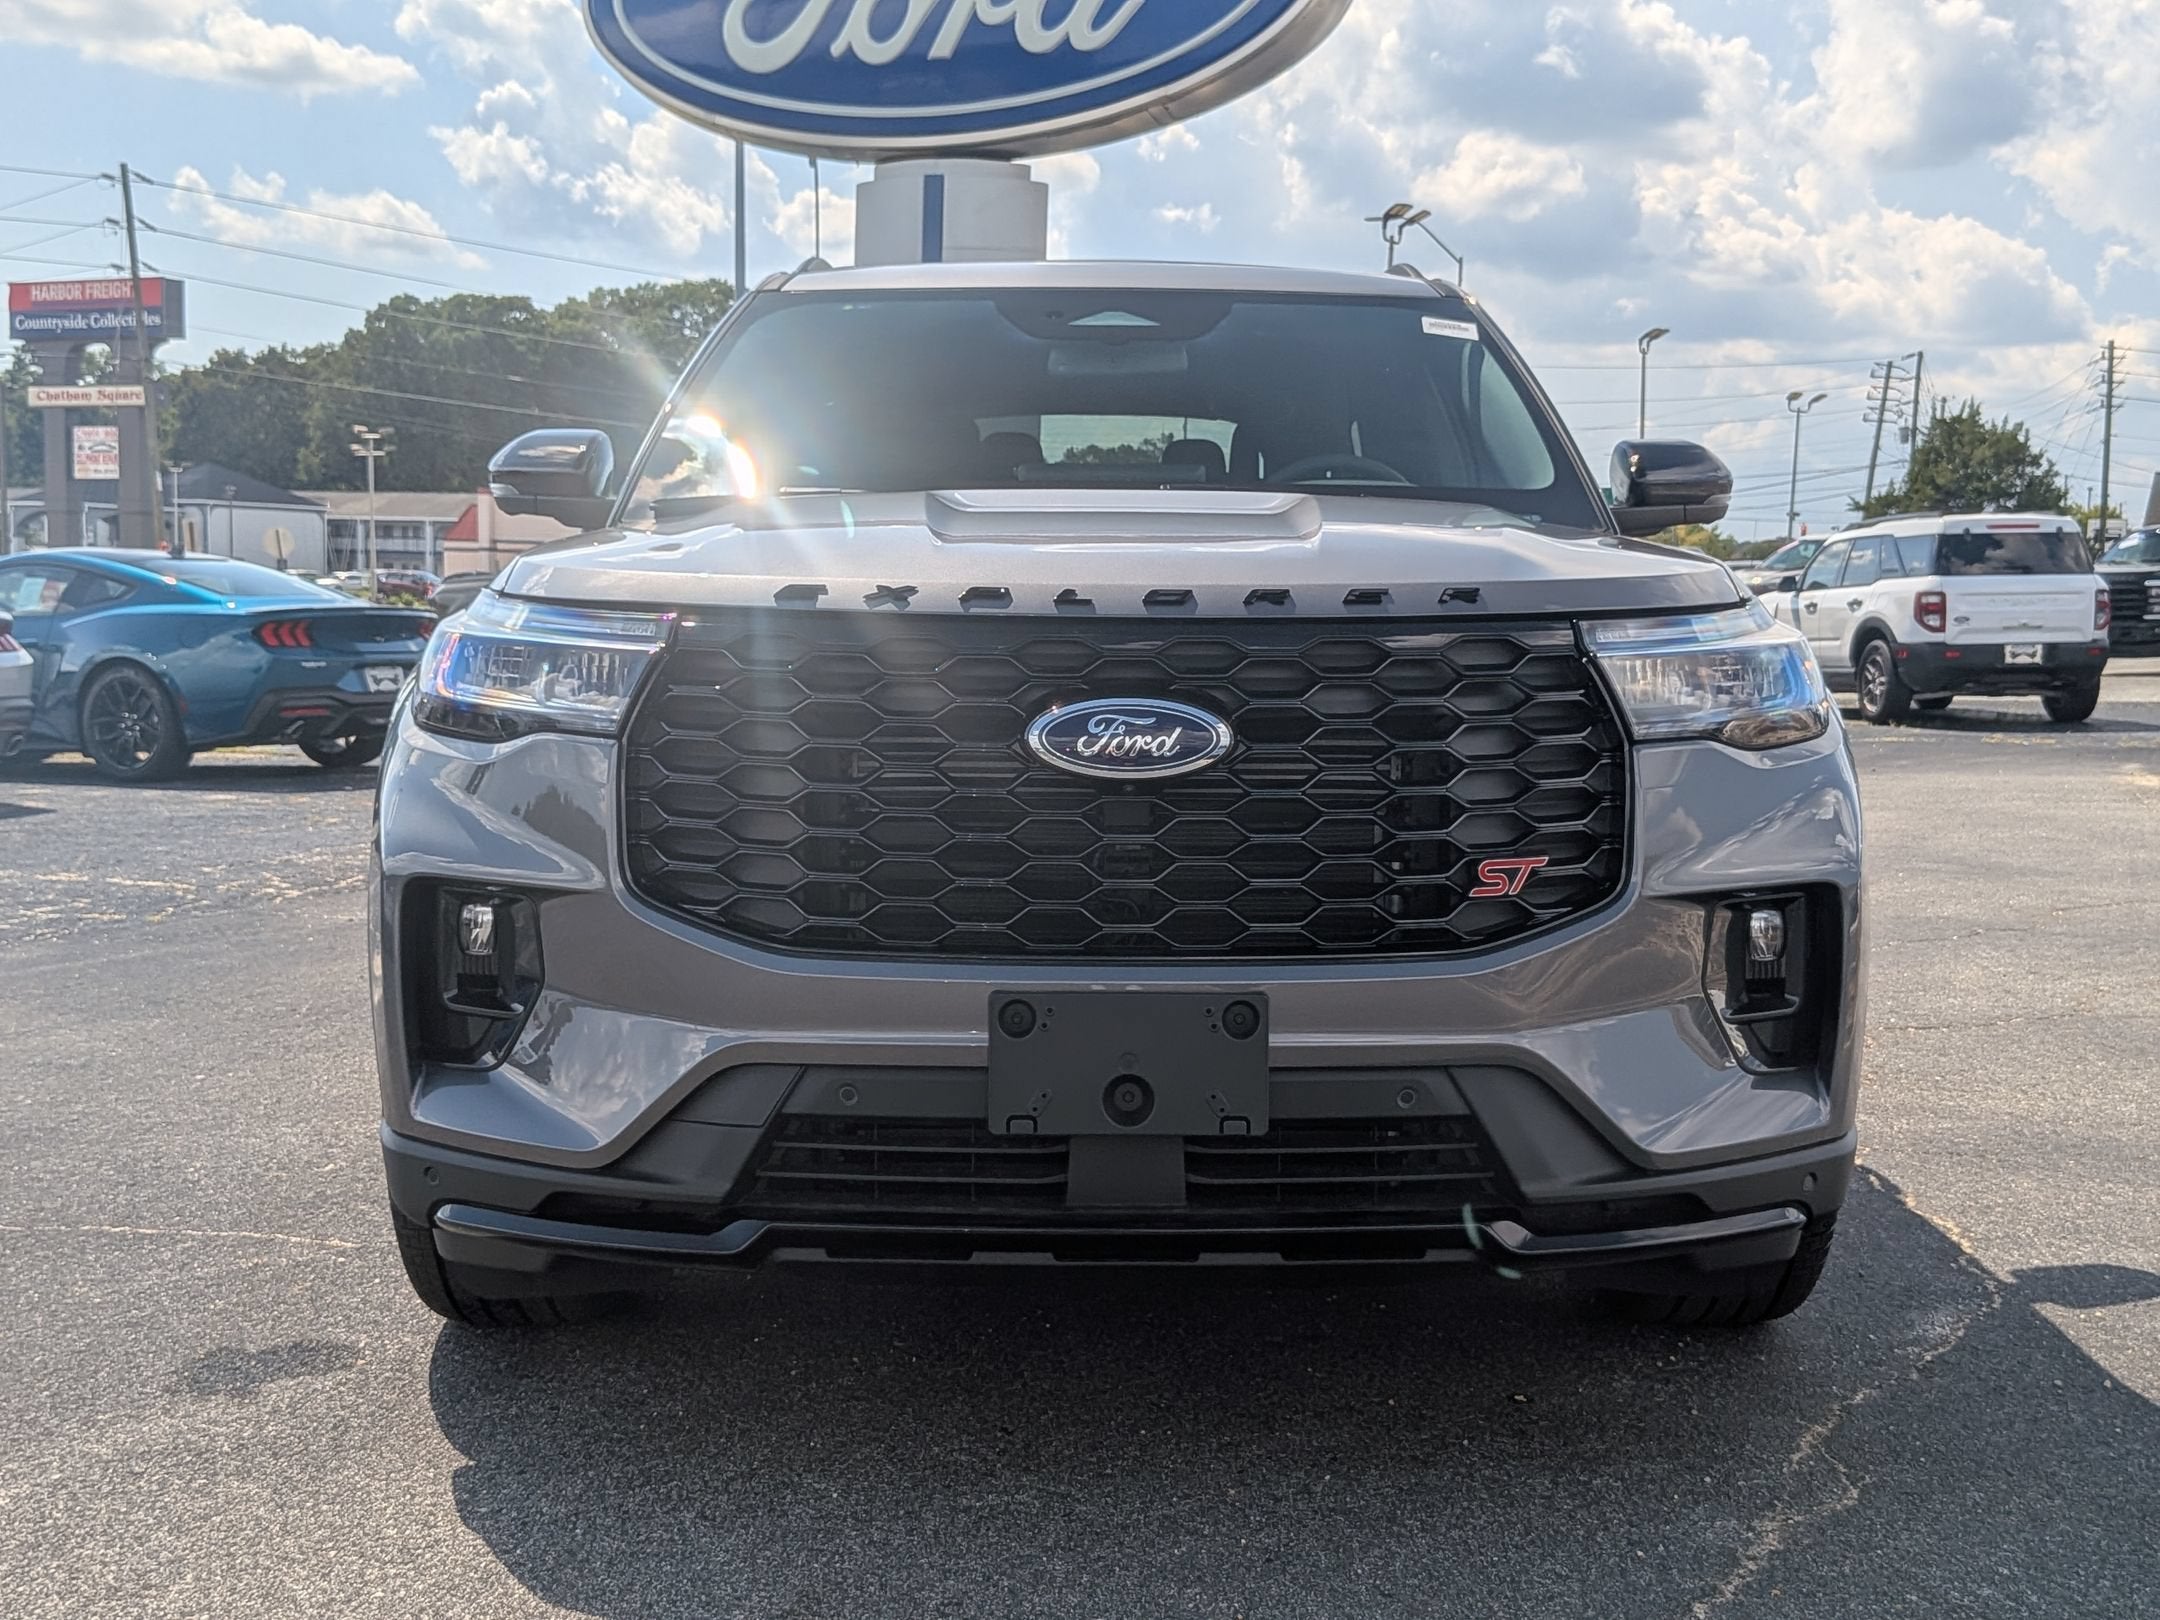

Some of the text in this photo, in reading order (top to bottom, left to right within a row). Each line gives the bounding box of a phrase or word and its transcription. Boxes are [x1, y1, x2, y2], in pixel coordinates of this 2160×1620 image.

[31, 282, 82, 301] HARBOR
[15, 310, 162, 333] Countryside Collectiles
[36, 389, 143, 402] Chatham Square
[1076, 713, 1183, 757] Ford
[1468, 856, 1550, 897] ST
